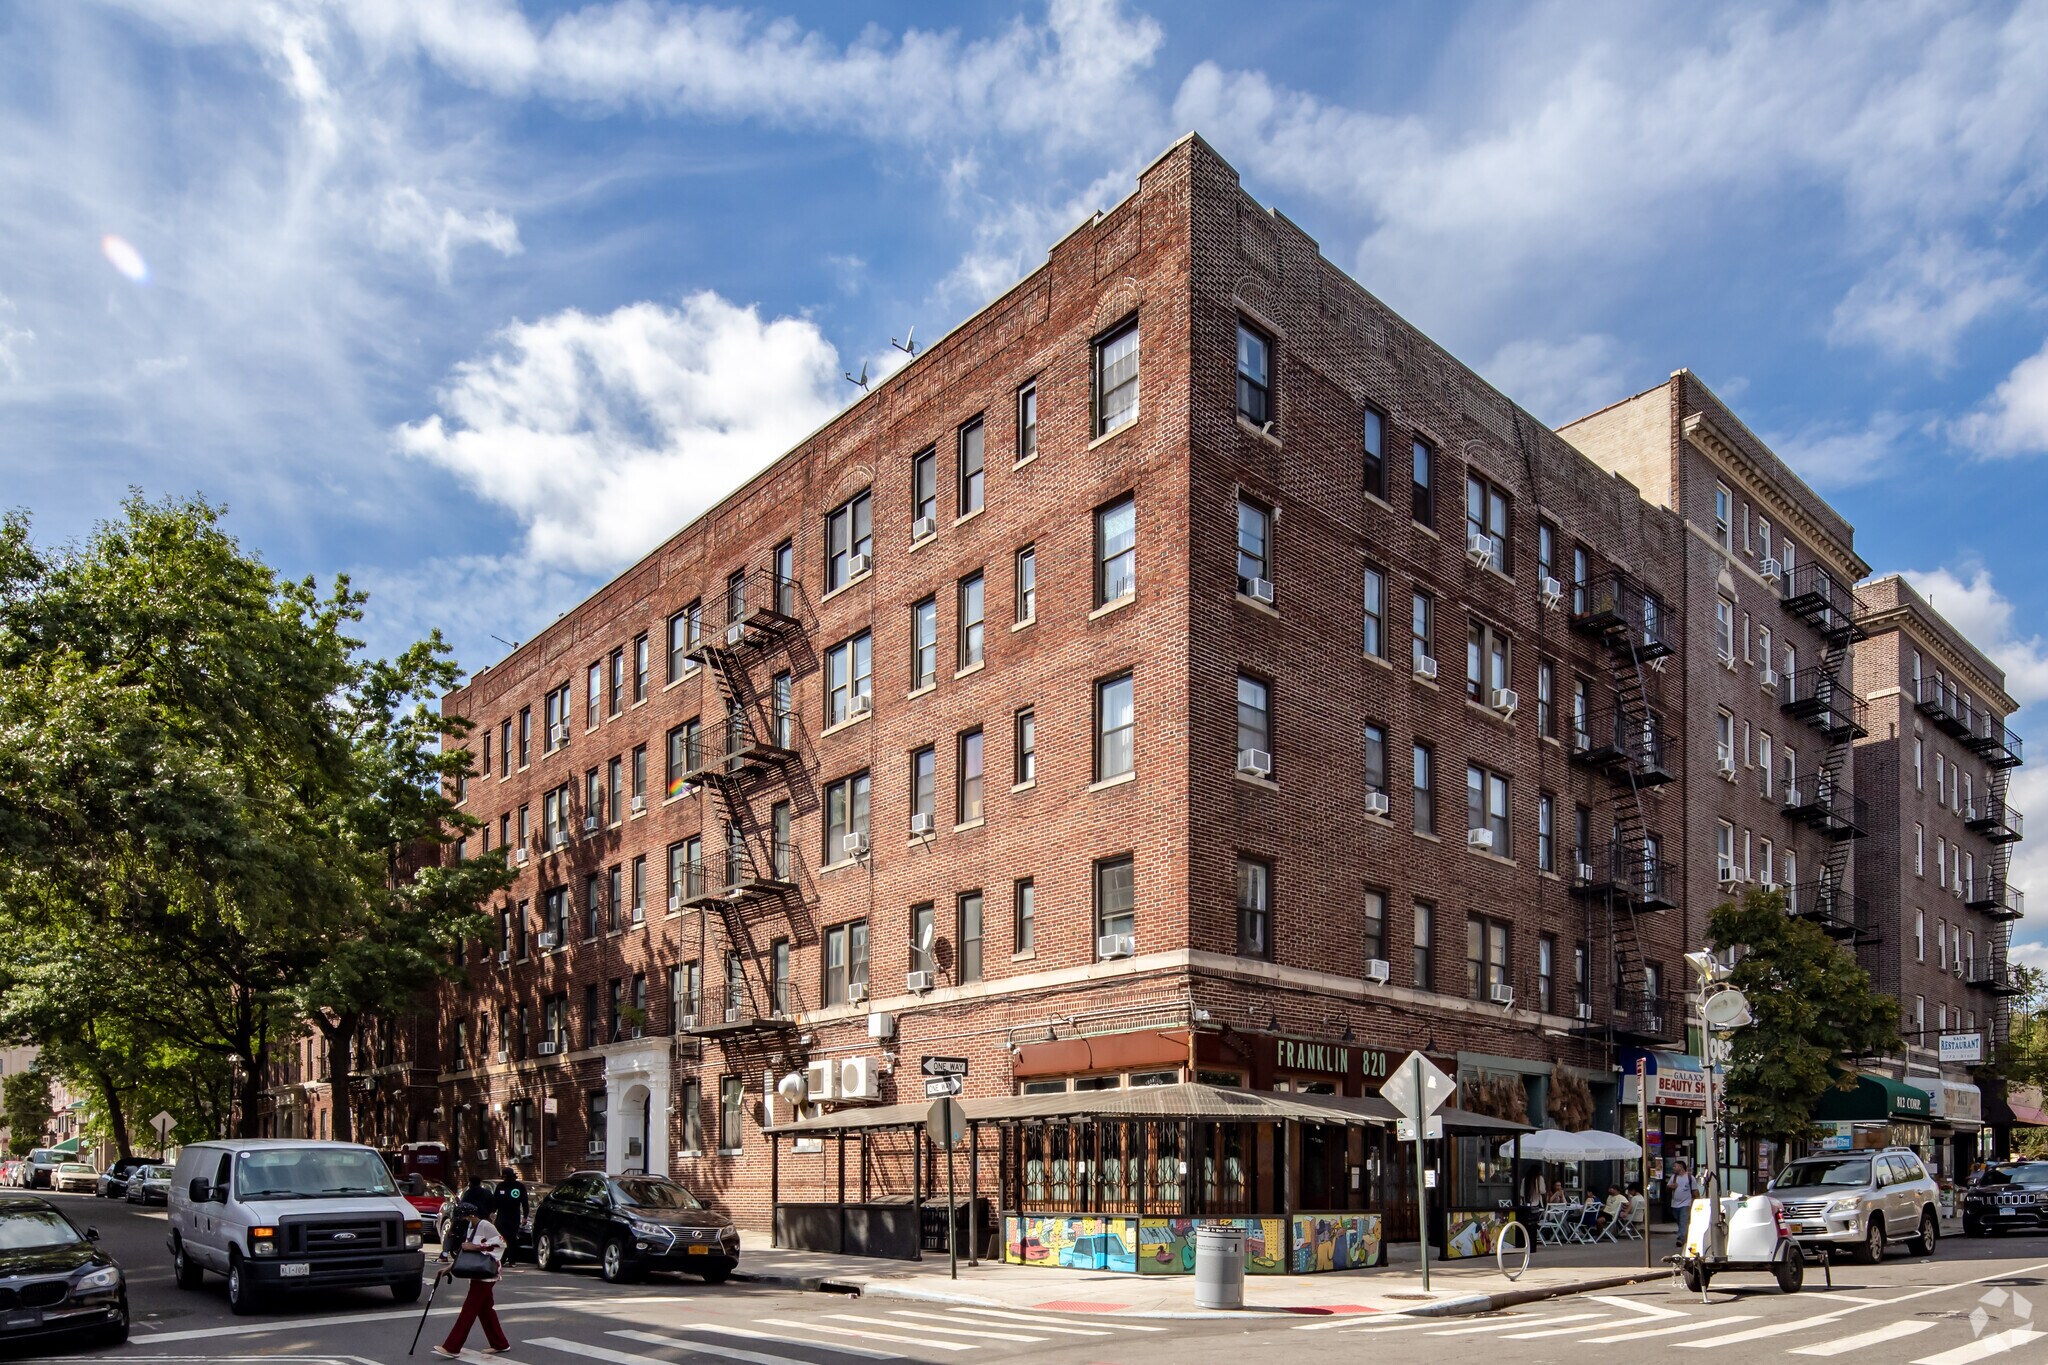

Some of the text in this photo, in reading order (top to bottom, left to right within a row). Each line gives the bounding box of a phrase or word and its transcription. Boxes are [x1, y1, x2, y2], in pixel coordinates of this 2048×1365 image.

[1941, 1038, 1979, 1050] RESTAURANT
[1278, 1041, 1386, 1077] FRANKLIN 820
[1674, 1072, 1704, 1081] GALAXY
[929, 1084, 939, 1092] ONE
[1659, 1078, 1716, 1094] BEAUTY SHP
[1897, 1096, 1905, 1108] 812
[1907, 1098, 1921, 1110] CORP.
